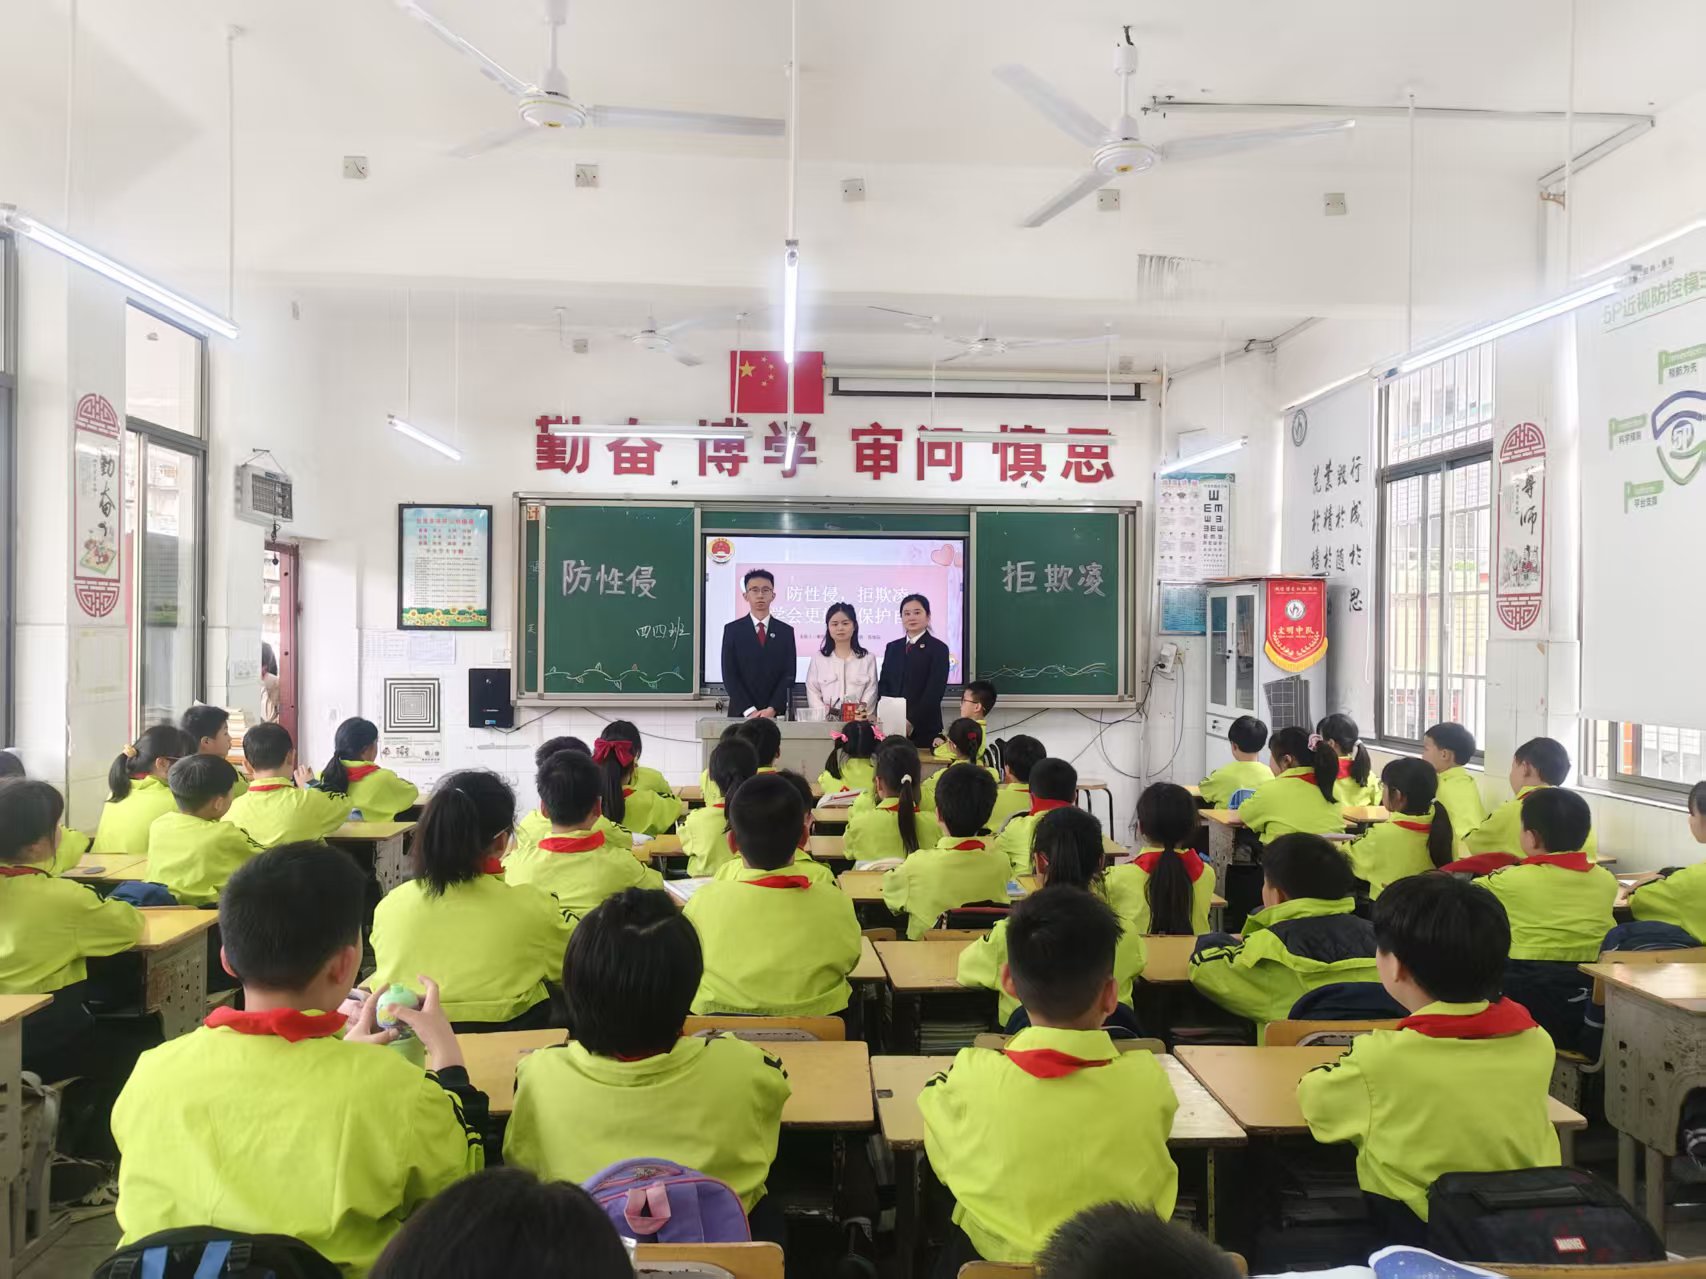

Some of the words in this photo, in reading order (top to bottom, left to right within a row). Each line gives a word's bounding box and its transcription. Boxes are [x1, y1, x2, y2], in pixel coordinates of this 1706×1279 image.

[698, 417, 818, 479] 博学
[851, 421, 964, 482] 审问
[991, 424, 1115, 484] 慎思
[562, 559, 657, 600] 防性侵
[1001, 560, 1106, 597] 拒欺凌
[635, 616, 691, 650] 四四班
